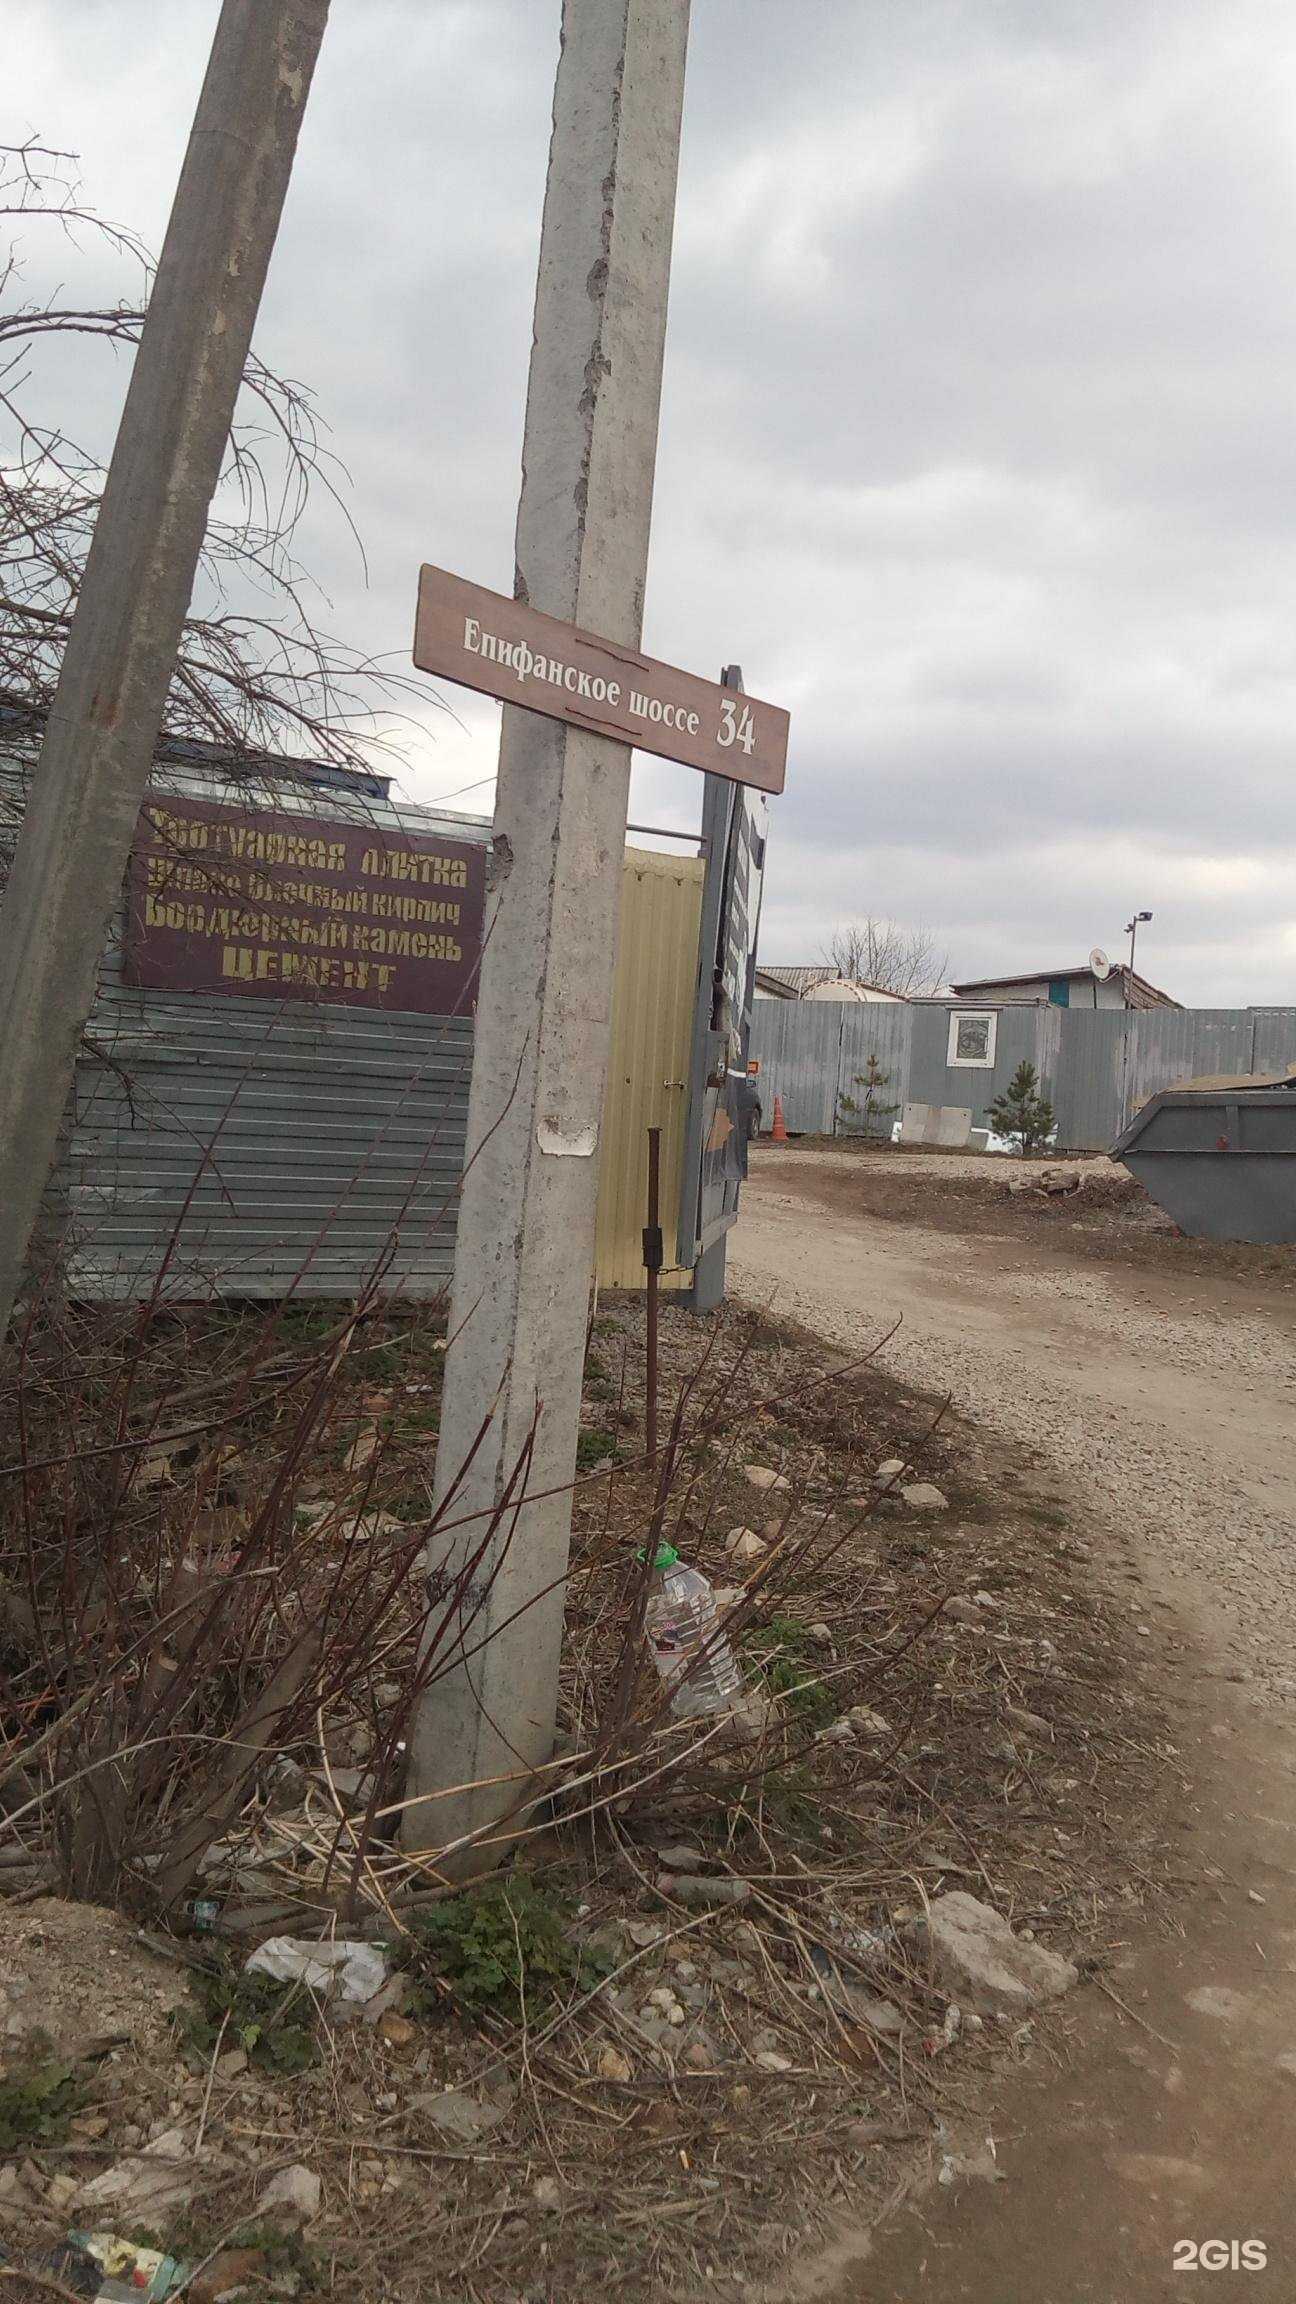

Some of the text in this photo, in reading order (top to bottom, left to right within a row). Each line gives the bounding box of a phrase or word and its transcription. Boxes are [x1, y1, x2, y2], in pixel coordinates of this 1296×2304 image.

[462, 616, 756, 755] Епифанское шоссе 34
[361, 848, 467, 888] плитка
[372, 893, 461, 926] кирпич
[352, 924, 462, 961] камень
[222, 945, 397, 992] ЦЕМЕНТ
